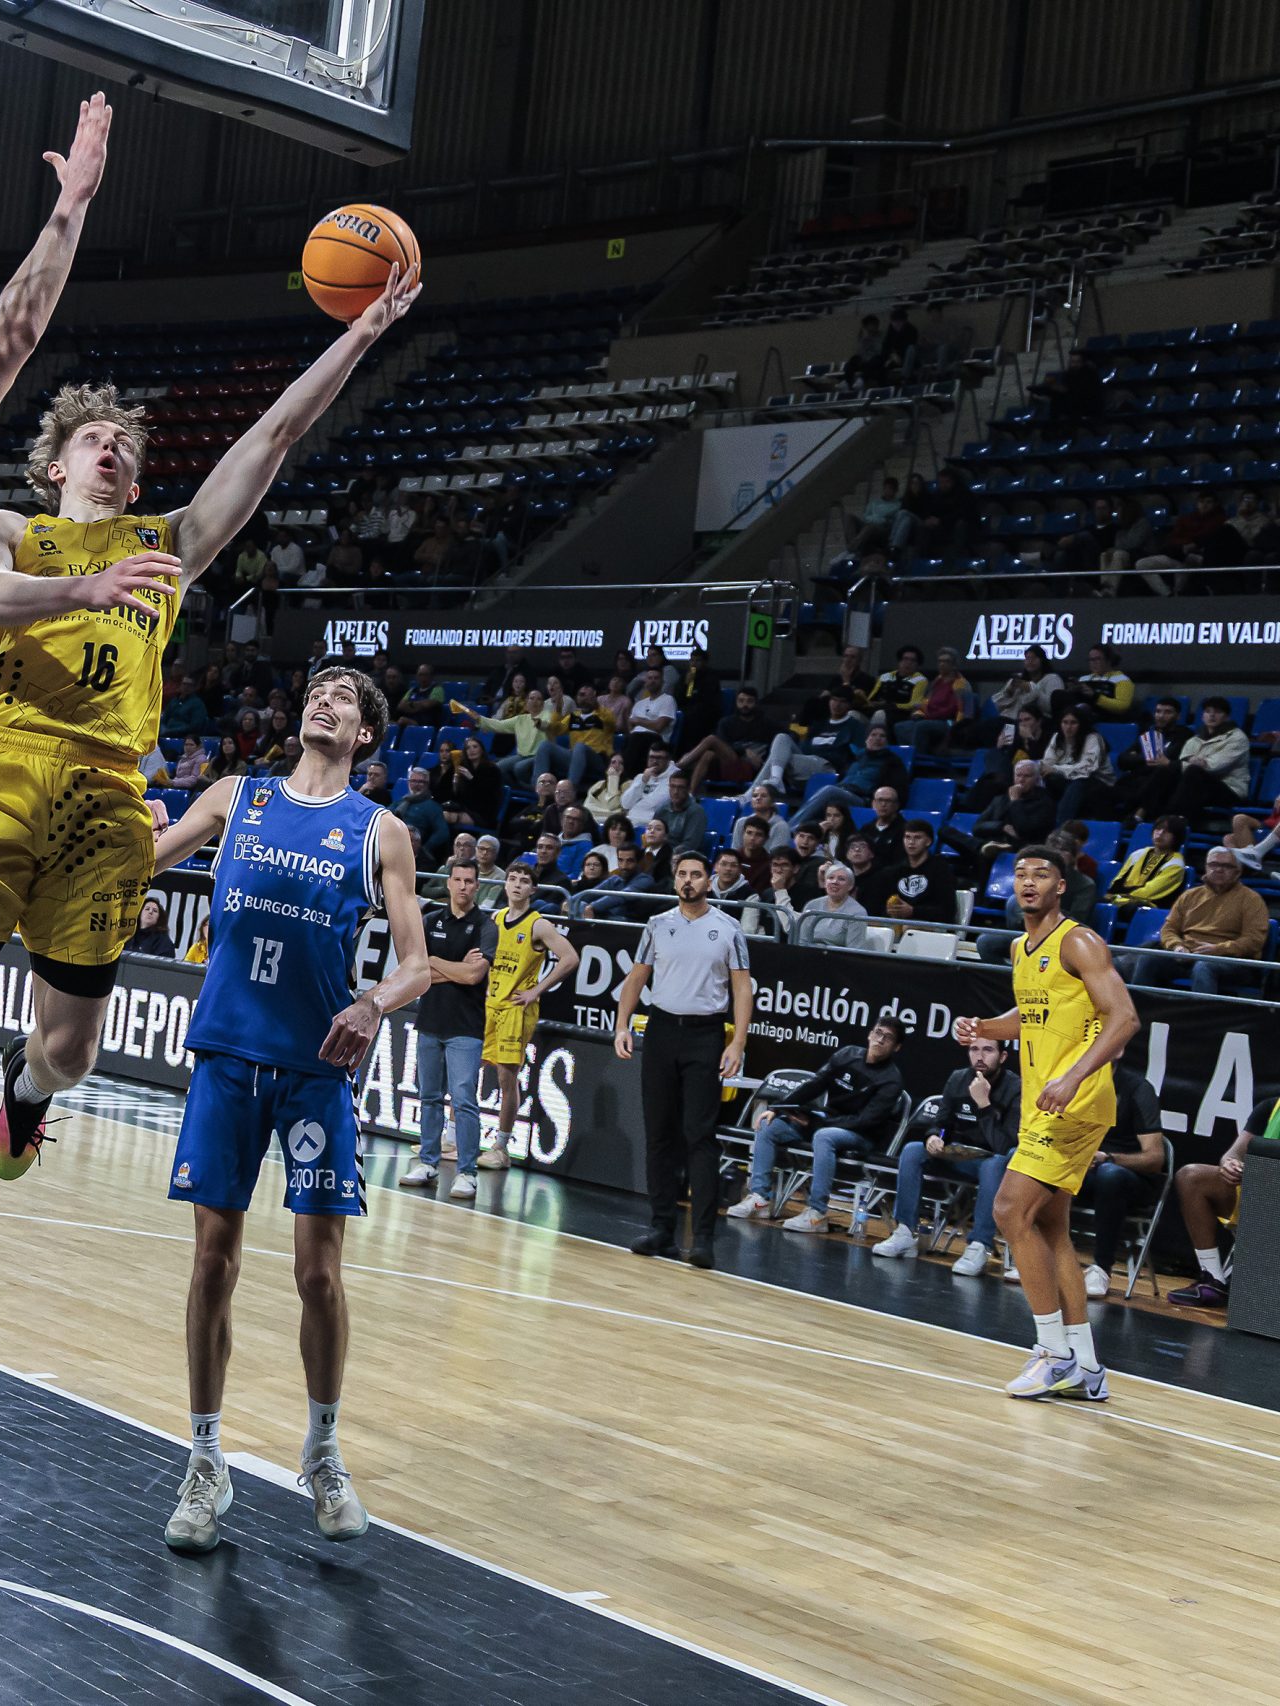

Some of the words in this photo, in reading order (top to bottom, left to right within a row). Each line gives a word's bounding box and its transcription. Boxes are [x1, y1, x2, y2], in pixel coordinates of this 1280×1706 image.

[324, 620, 390, 655] APELES
[405, 629, 463, 646] FORMANDO
[464, 630, 480, 646] EN
[482, 630, 532, 647] VALORES
[534, 629, 604, 648] DEPORTIVOS
[627, 619, 709, 660] APELES
[966, 613, 1074, 660] APELES
[1101, 623, 1195, 644] FORMANDO
[1198, 622, 1223, 644] EN
[74, 641, 120, 693] 16
[235, 833, 260, 843] GRUPO
[233, 842, 345, 881] DESANTIAGO
[244, 895, 300, 918] BURGOS
[301, 907, 332, 928] 2031
[250, 935, 283, 985] 13
[796, 1028, 839, 1048] Martín
[289, 1160, 336, 1196] ágora
